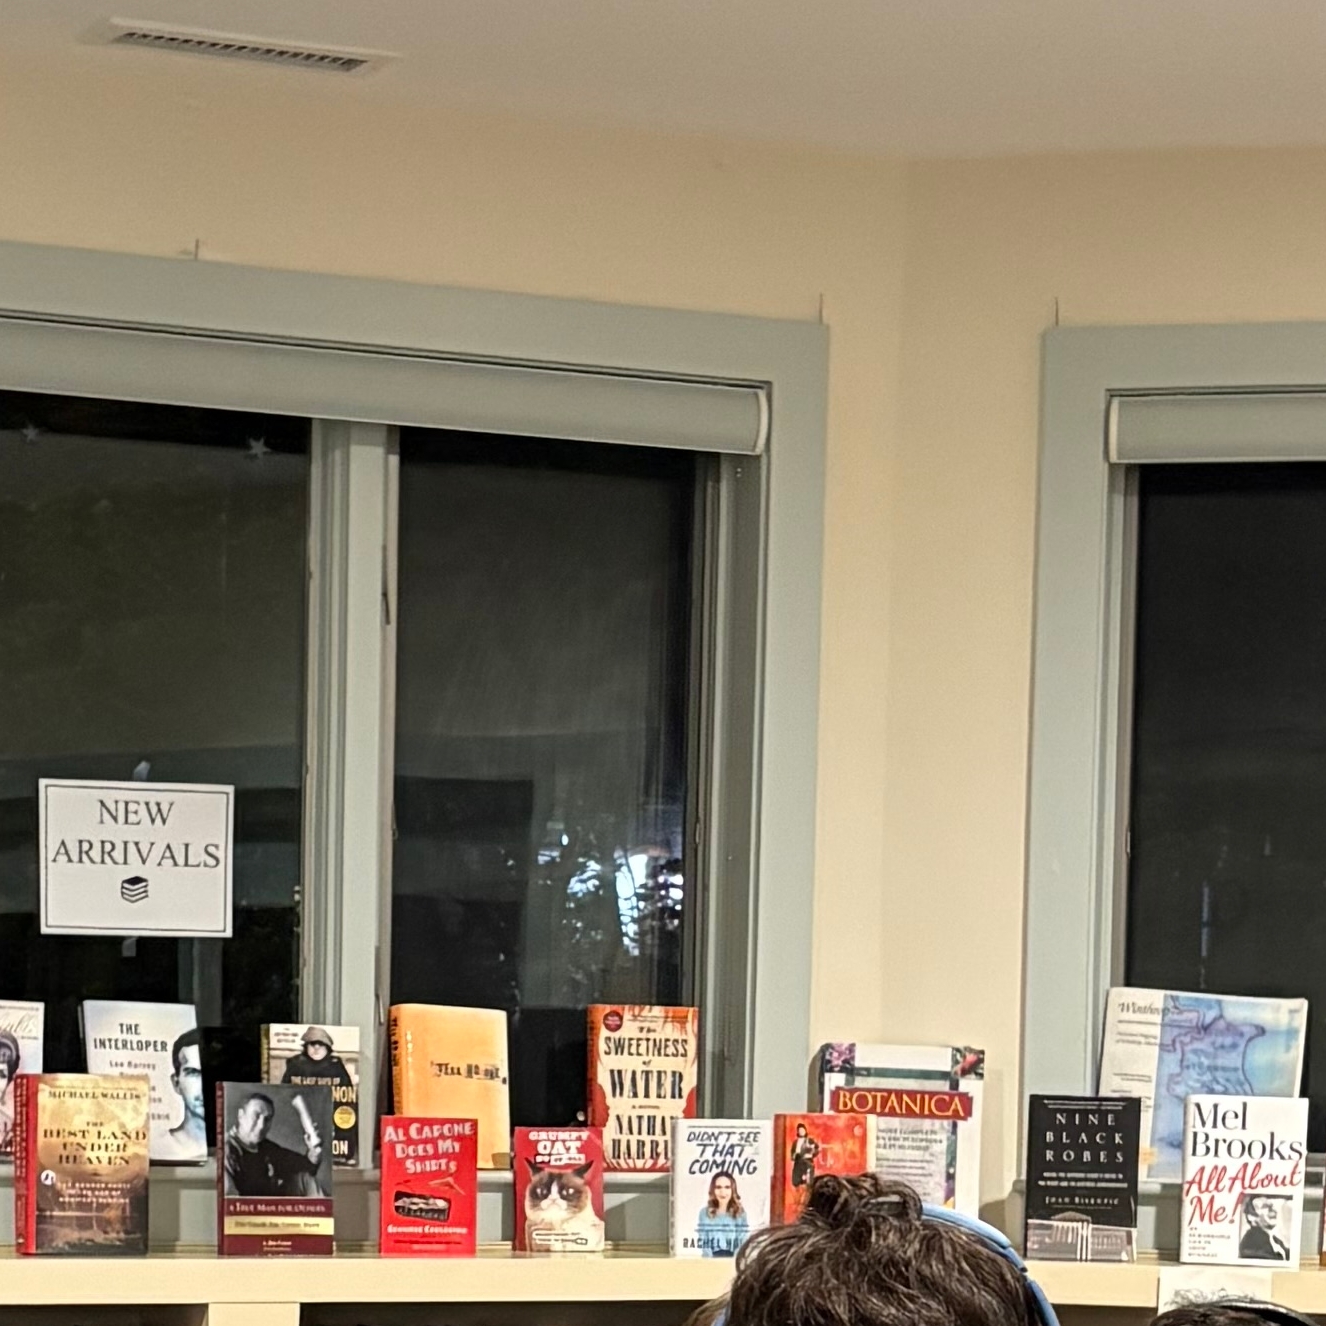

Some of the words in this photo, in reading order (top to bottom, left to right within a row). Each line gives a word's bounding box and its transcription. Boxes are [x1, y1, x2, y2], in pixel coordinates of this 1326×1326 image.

[97, 798, 175, 826] NEW
[51, 839, 221, 869] ARRIVALS
[118, 1023, 141, 1035] THE
[93, 1037, 168, 1053] INTERLOPER
[603, 1036, 688, 1058] SWEETNESS
[609, 1069, 685, 1100] WATER
[838, 1089, 965, 1117] BOTANICA
[1055, 1112, 1116, 1126] NINE
[1191, 1102, 1248, 1131] Mel
[43, 1128, 90, 1140] BEST
[96, 1129, 147, 1141] LAND
[737, 1131, 761, 1143] SEE
[1045, 1131, 1124, 1145] BLACK
[62, 1141, 128, 1153] UNDER
[536, 1141, 582, 1155] CAT
[697, 1144, 748, 1158] THAT
[1190, 1131, 1304, 1161] Brooks
[58, 1154, 132, 1166] HEAVEN
[1045, 1150, 1124, 1163] ROBES
[688, 1159, 758, 1177] COMING
[1185, 1165, 1225, 1196] All
[1228, 1161, 1302, 1194] About
